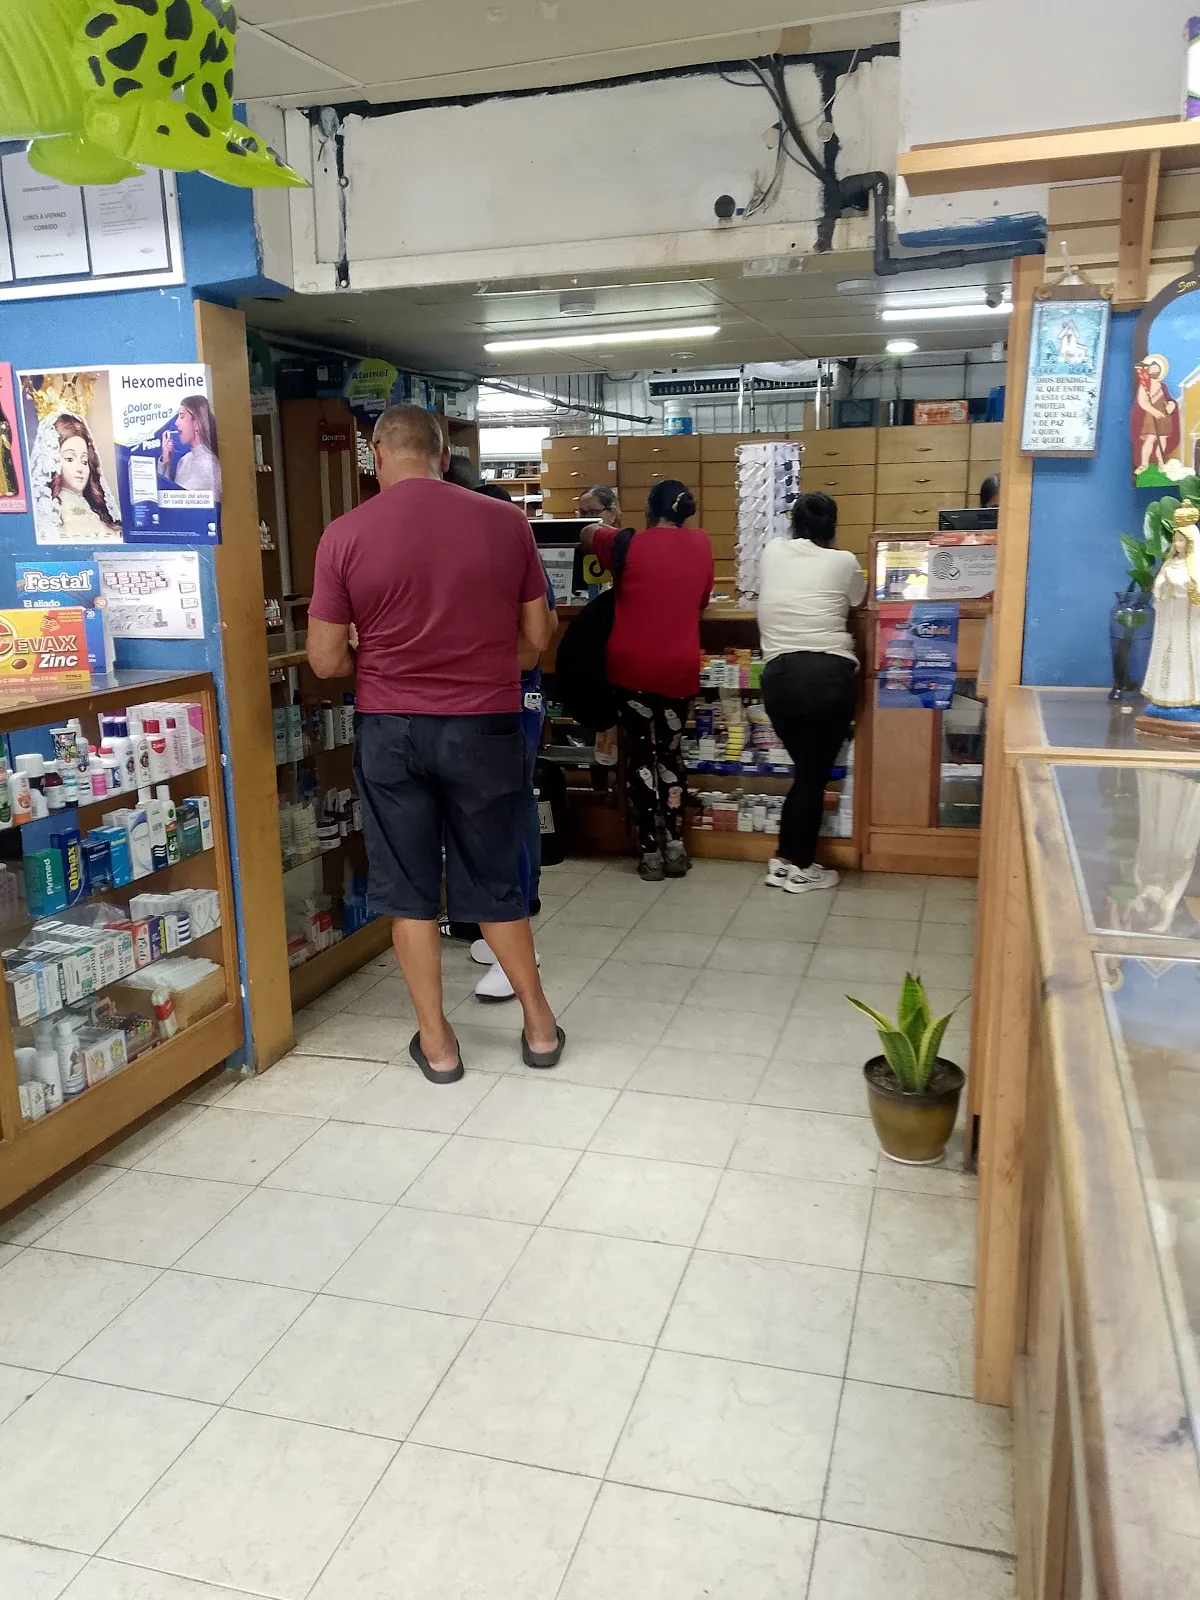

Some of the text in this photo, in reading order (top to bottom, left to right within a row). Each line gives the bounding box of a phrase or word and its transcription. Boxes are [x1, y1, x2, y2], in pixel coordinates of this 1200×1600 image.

[23, 213, 39, 221] LUNES
[121, 373, 204, 389] Hexomedine
[123, 402, 152, 416] ¿Dolor
[123, 408, 173, 428] garganta?
[24, 570, 92, 592] Festal
[23, 599, 61, 608] El aliado
[86, 610, 95, 618] 20
[39, 653, 78, 668] Zinc
[90, 952, 98, 984] Brucen
[99, 953, 107, 984] Brucen
